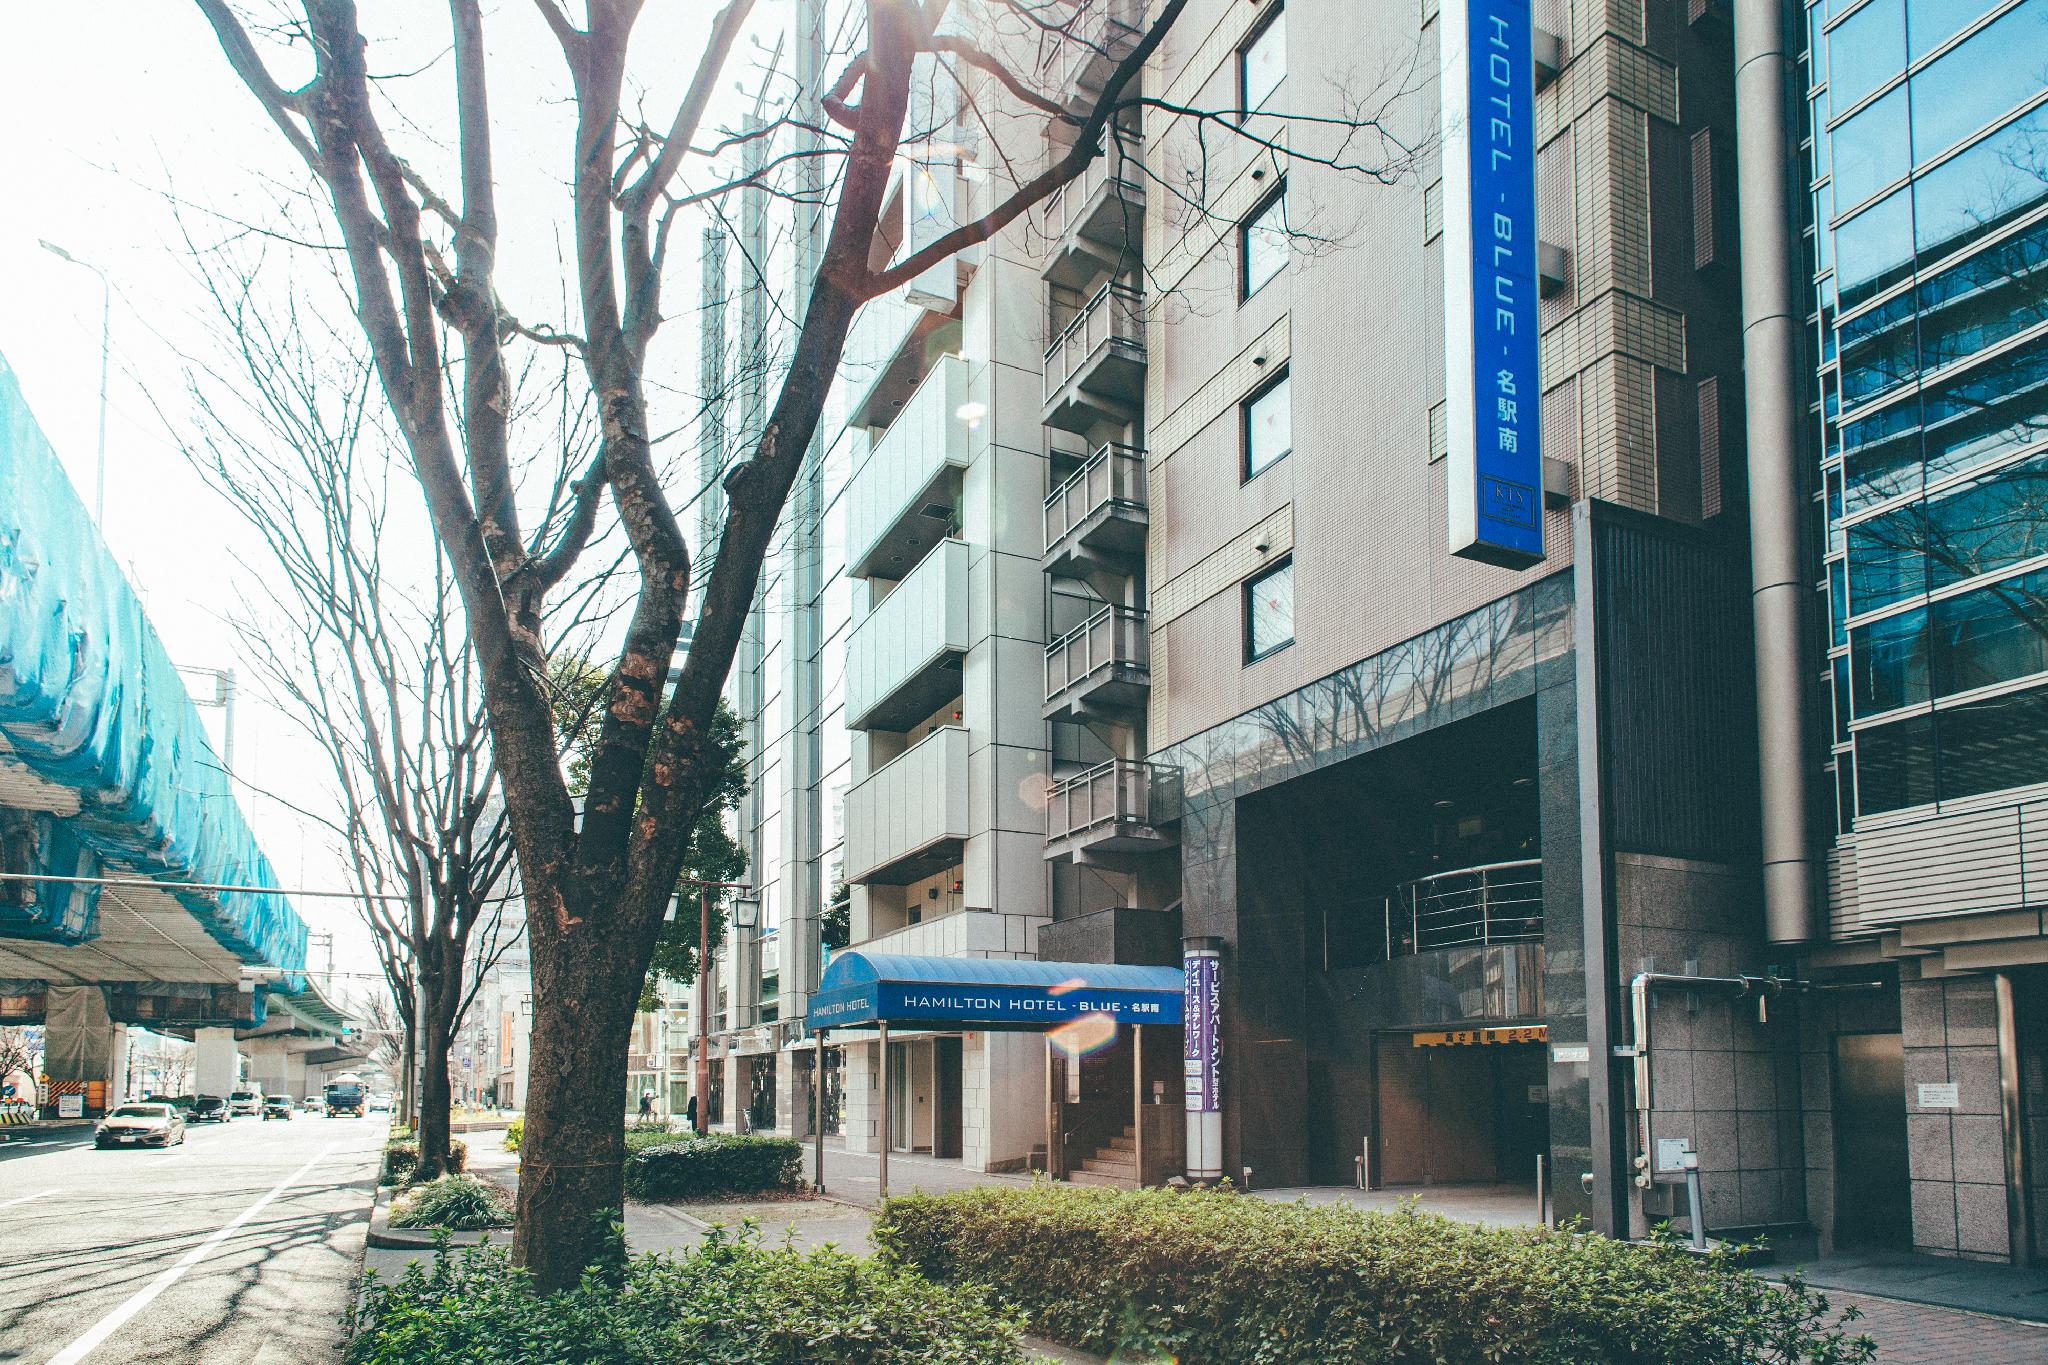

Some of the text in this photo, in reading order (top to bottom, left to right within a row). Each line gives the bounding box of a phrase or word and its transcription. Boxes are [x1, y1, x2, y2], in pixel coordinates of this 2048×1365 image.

[1489, 15, 1512, 172] HOTEL
[1496, 368, 1518, 455] 名駅南
[813, 998, 870, 1018] HAMILTON HOTEL
[904, 995, 1001, 1009] HAMILTON
[1009, 999, 1067, 1011] HOTEL
[1508, 1028, 1532, 1039] 2.2
